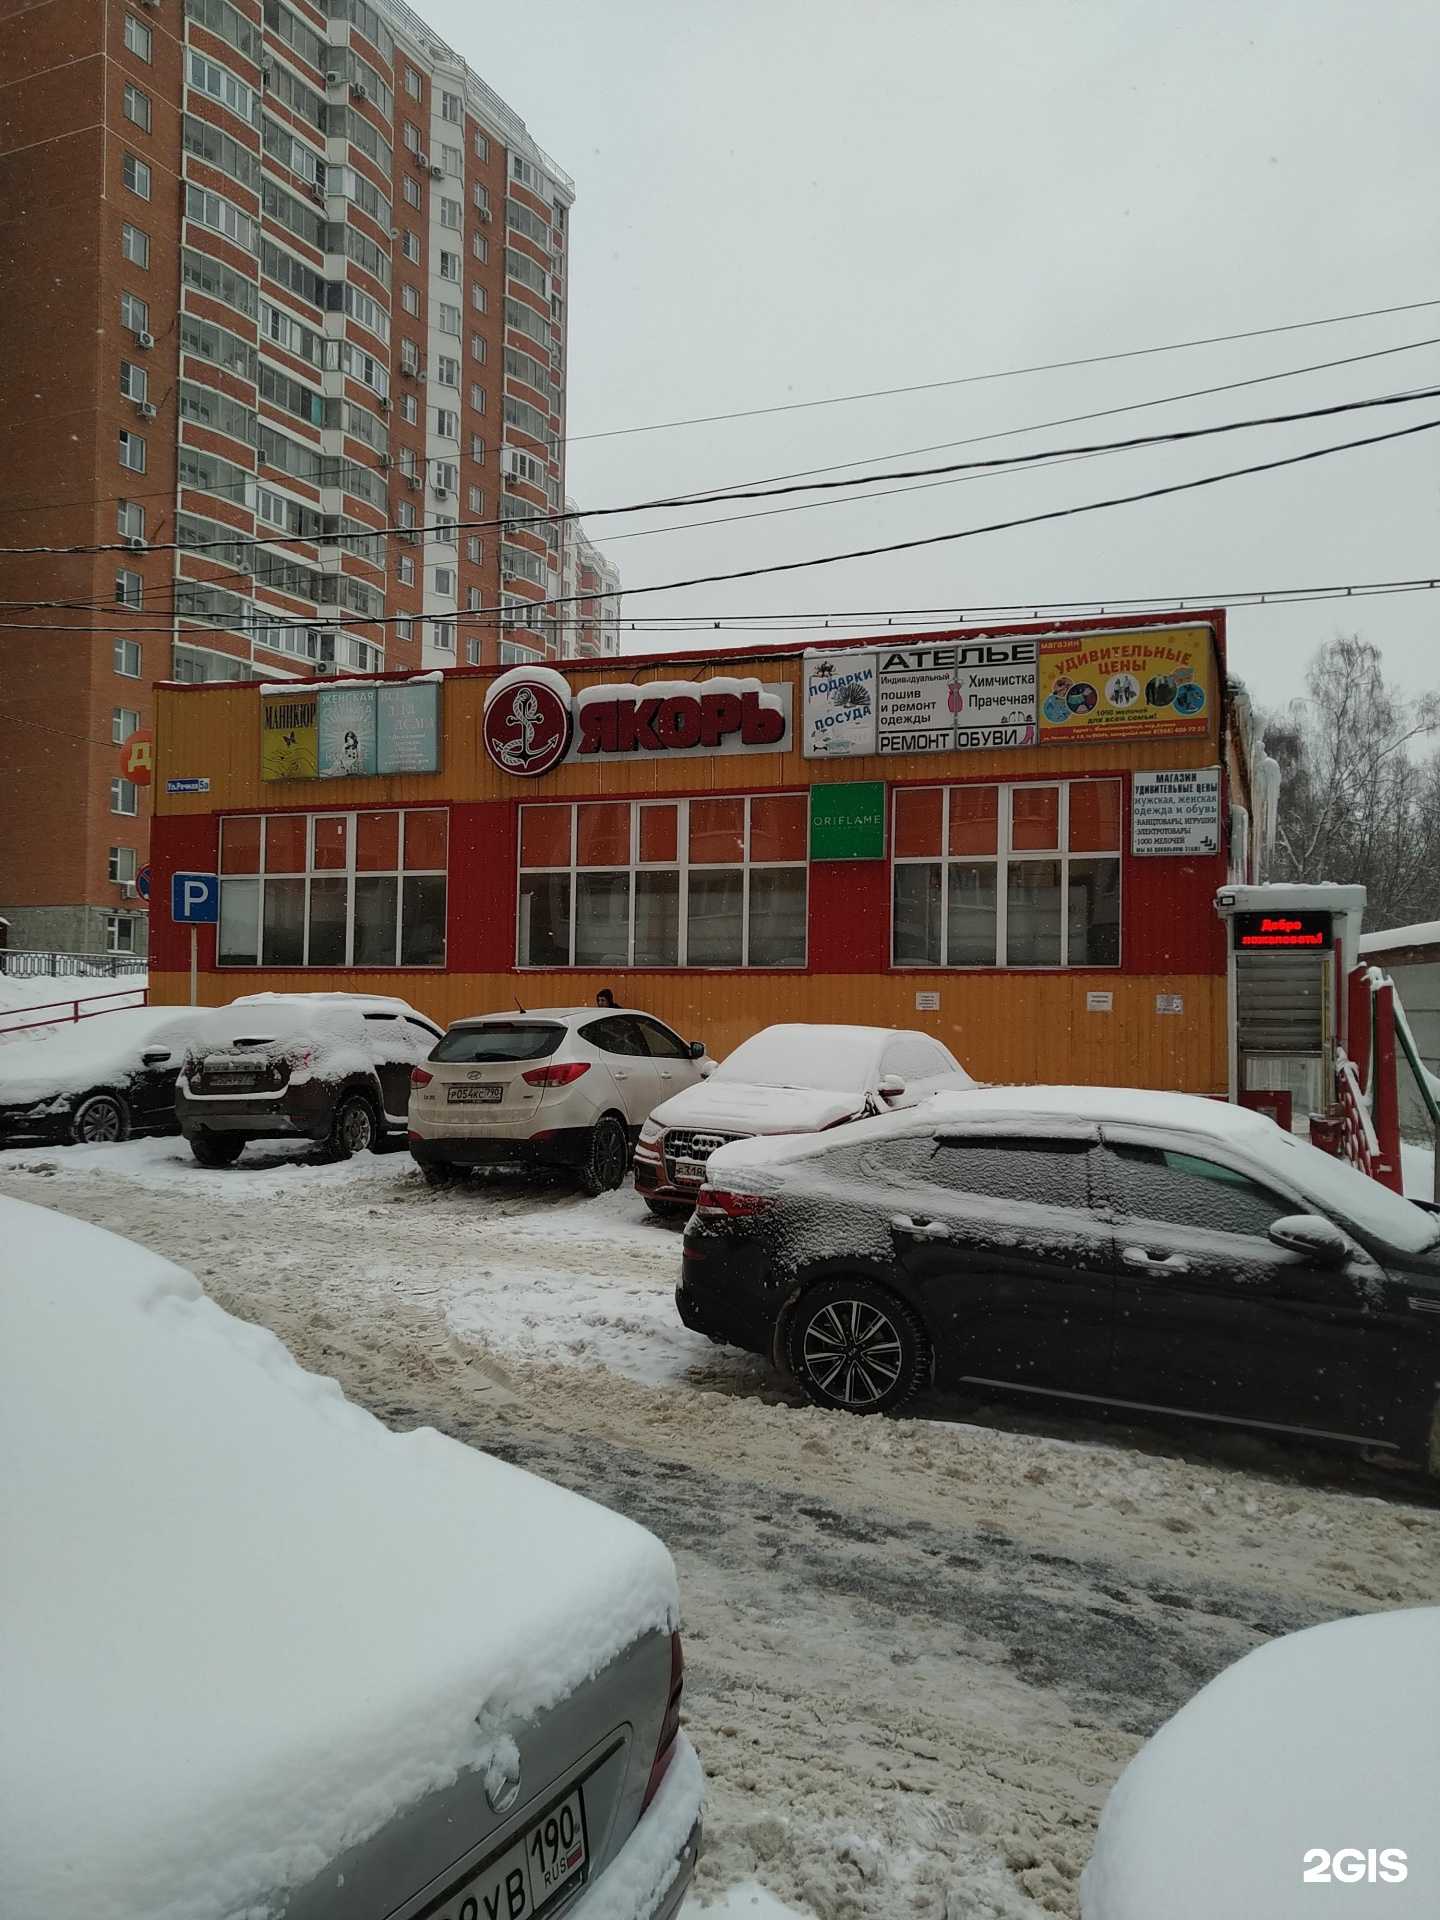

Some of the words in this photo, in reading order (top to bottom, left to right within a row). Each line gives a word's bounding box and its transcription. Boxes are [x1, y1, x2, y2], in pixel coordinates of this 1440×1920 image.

[881, 643, 1035, 670] АТЕЛЬЕ
[1055, 645, 1192, 674] УДИВИТЕЛЬНЫЕ
[1098, 661, 1147, 675] ЦЕНЫ
[808, 668, 873, 697] ПОДАРКИ
[880, 673, 950, 685] Индивидуальный
[968, 673, 1035, 688] Химчистка
[880, 690, 921, 701] пошив
[968, 693, 1035, 711] Прачечная
[264, 703, 316, 729] МАНИКЮР
[880, 703, 888, 713] и
[891, 701, 937, 715] ремонт
[577, 691, 786, 754] ЯКОРЬ
[814, 705, 872, 731] ПОСУДА
[880, 715, 931, 726] одежды
[880, 733, 950, 751] РЕМОНТ
[957, 729, 1018, 747] ОБУВИ
[1156, 773, 1197, 783] МАГАЗИН
[1135, 784, 1194, 795] УДИВИТЕЛЬНЫЕ
[1196, 783, 1217, 794] ЦЕНЫ
[1134, 807, 1173, 817] одежда
[1176, 806, 1183, 814] и
[1185, 803, 1217, 816] обувь
[813, 816, 881, 829] ORIFLAME
[184, 881, 208, 916] P
[1261, 919, 1302, 932] Добро
[530, 1805, 576, 1874] 190
[543, 1856, 568, 1890] RUS
